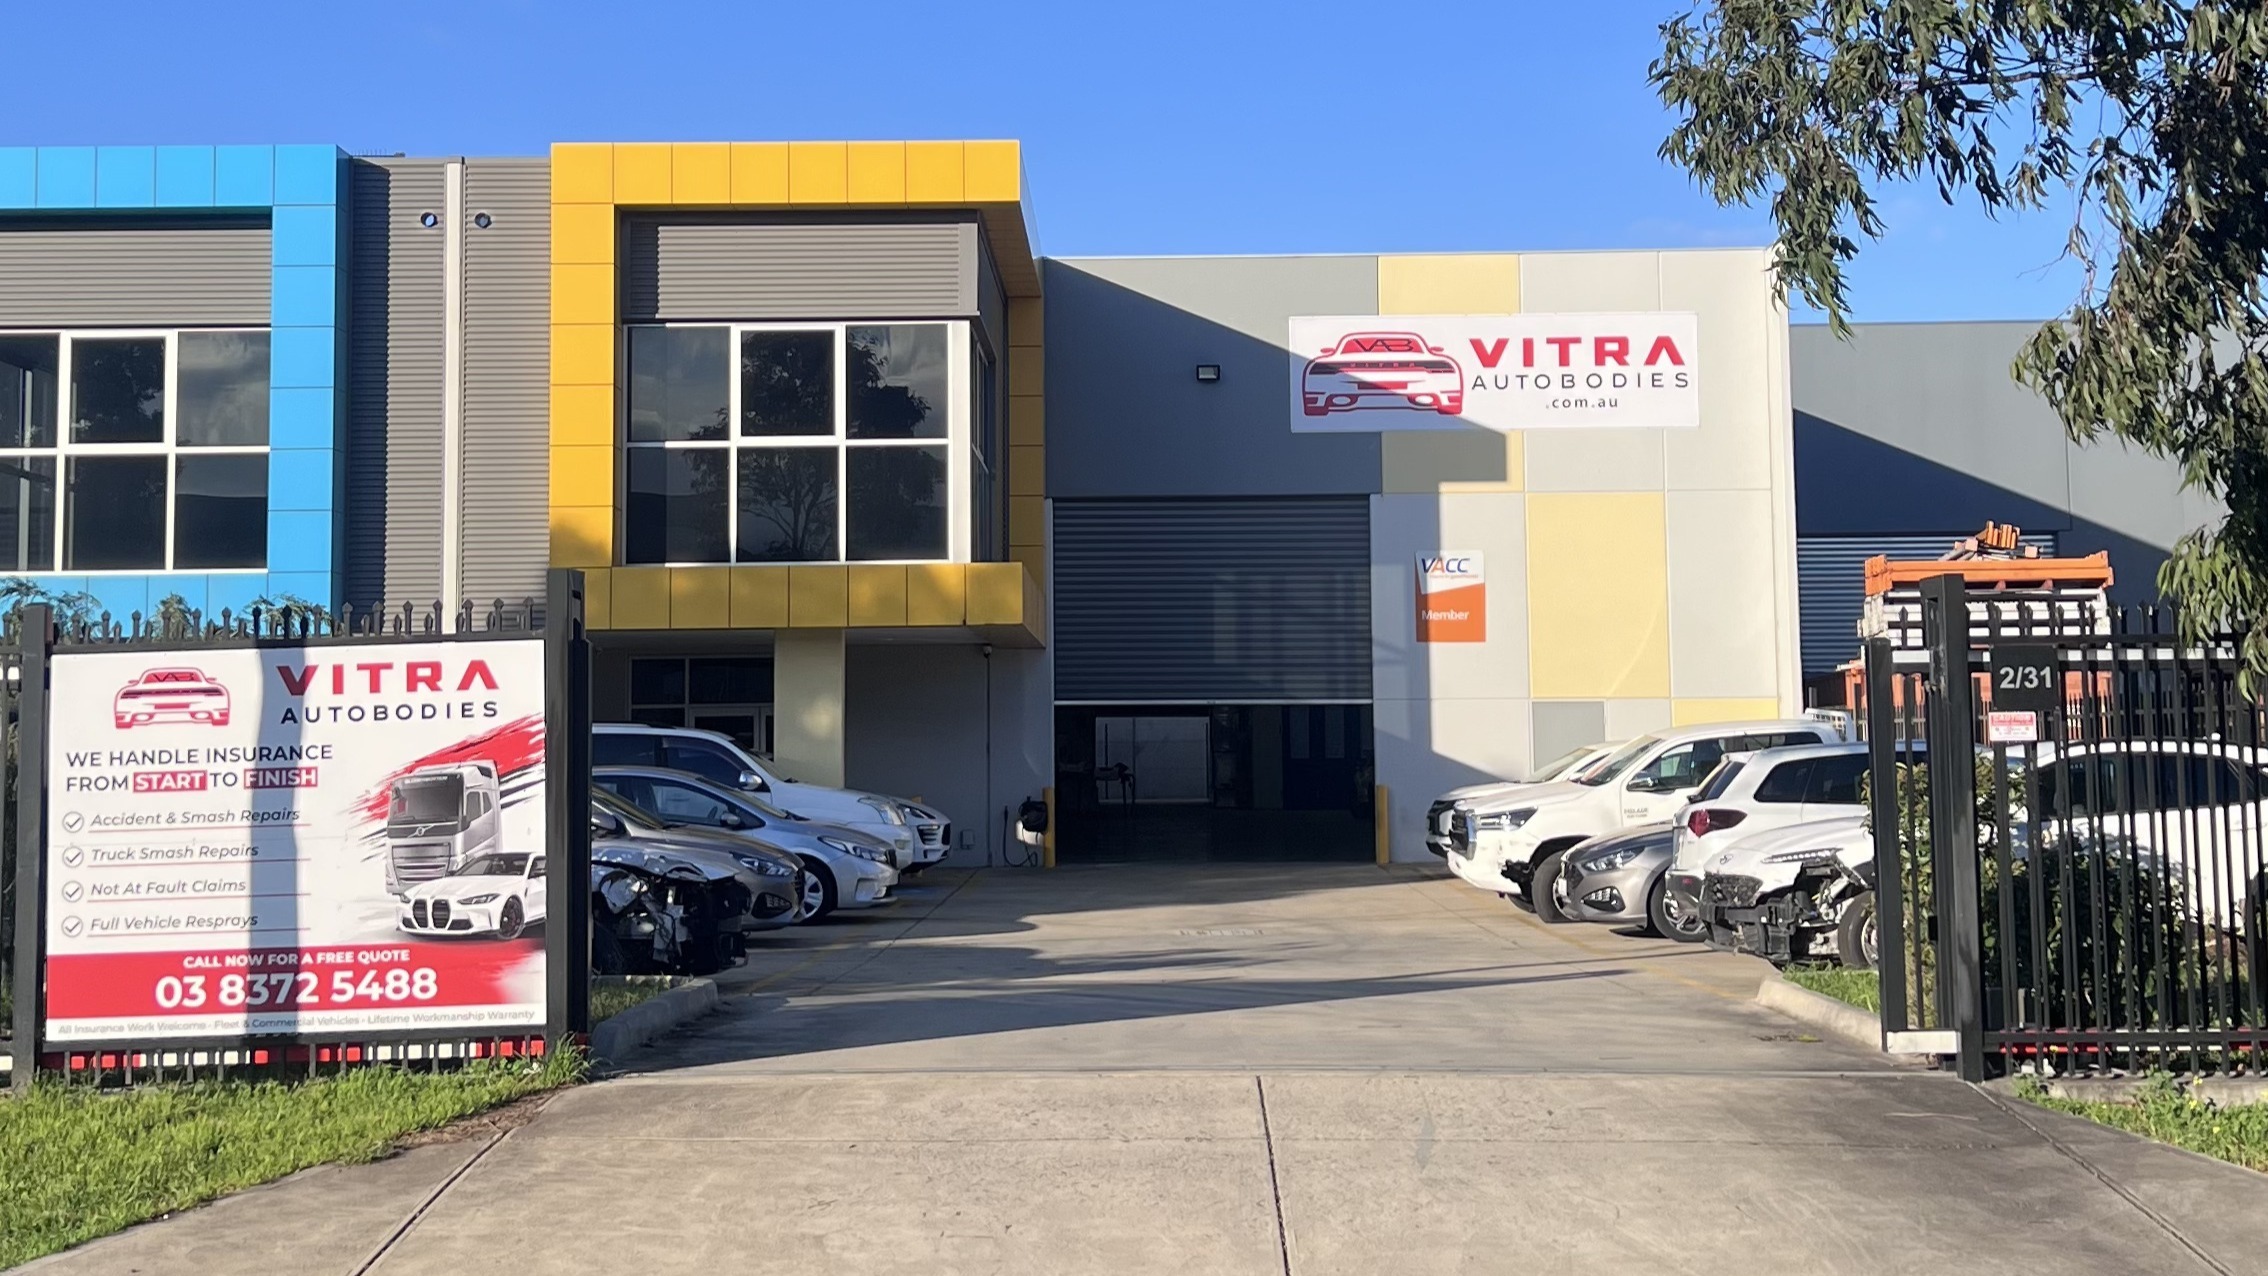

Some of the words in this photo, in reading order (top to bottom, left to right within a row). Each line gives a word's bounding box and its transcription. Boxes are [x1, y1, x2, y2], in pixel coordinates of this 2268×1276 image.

[1469, 336, 1685, 368] VITRA
[1472, 373, 1688, 390] AUTOBODIES
[1546, 397, 1618, 409] .com.au
[1421, 557, 1470, 573] VACC
[1421, 609, 1470, 620] Member
[276, 660, 499, 696] VITRA
[1999, 666, 2051, 688] 2/31
[281, 702, 498, 724] AUTOBODIES
[66, 752, 102, 767] WE
[109, 748, 199, 767] HANDLE
[206, 744, 333, 764] INSURANCE
[66, 775, 129, 792] FROM
[135, 772, 204, 791] START
[210, 772, 238, 788] TO
[246, 769, 317, 788] FINISH
[90, 812, 161, 826] Accident
[166, 811, 176, 823] &
[181, 810, 235, 823] Smash
[240, 807, 300, 822] Repairs
[92, 848, 135, 861] Truck
[139, 846, 193, 860] Smash
[199, 844, 259, 859] Repairs
[91, 883, 119, 896] Not
[122, 883, 141, 895] At
[146, 880, 187, 894] Fault
[192, 879, 246, 893] Claims
[90, 917, 119, 931] Full
[125, 915, 181, 930] Vehicle
[186, 913, 258, 930] Resprays
[183, 956, 222, 968] CALL
[226, 954, 263, 967] NOW
[268, 954, 298, 966] FOR
[302, 953, 313, 964] A
[317, 952, 355, 964] FREE
[357, 949, 410, 964] QUOTE
[155, 975, 206, 1008] 03
[218, 971, 319, 1007] 8372
[330, 967, 438, 1003] 5488
[58, 1025, 72, 1034] All
[74, 1024, 124, 1034] Insurance
[127, 1023, 154, 1032] Work
[158, 1021, 206, 1031] Welcome
[214, 1020, 239, 1029] Fleet
[252, 1016, 314, 1028] Commercial
[317, 1014, 359, 1025] Vehicles
[368, 1013, 409, 1024] Lifetime
[413, 1011, 485, 1023] Workmanship
[488, 1009, 535, 1021] Warranty
